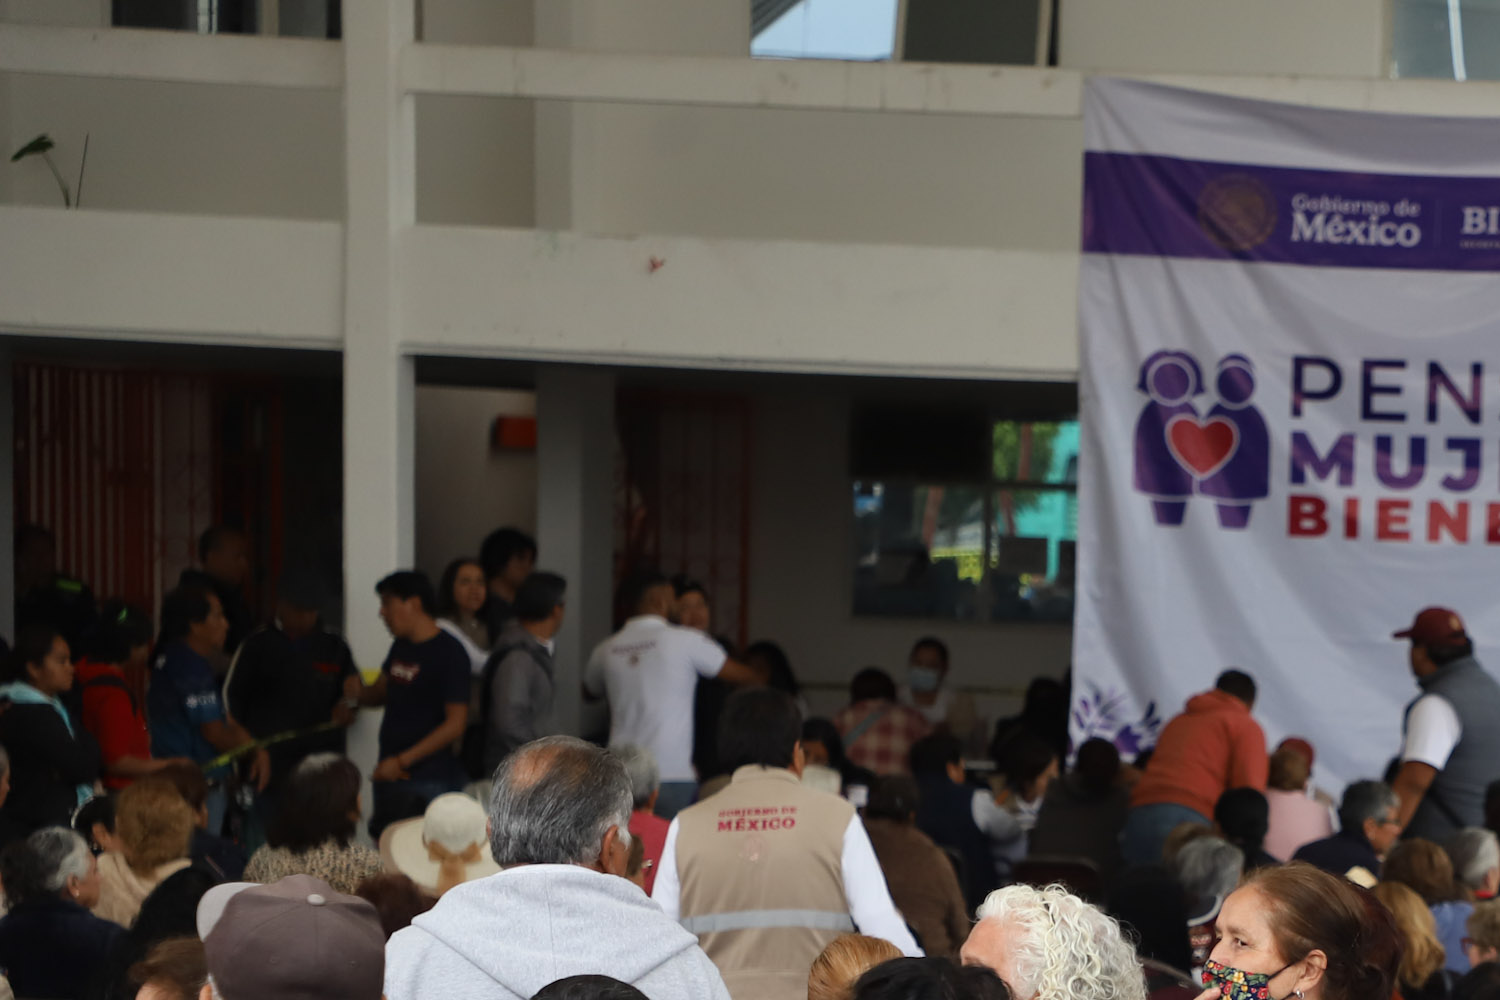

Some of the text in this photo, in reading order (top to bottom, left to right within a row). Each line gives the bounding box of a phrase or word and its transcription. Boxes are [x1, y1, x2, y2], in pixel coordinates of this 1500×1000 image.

[1291, 193, 1421, 218] Gobierno de
[1291, 211, 1421, 247] México
[717, 816, 796, 832] MÉXICO
